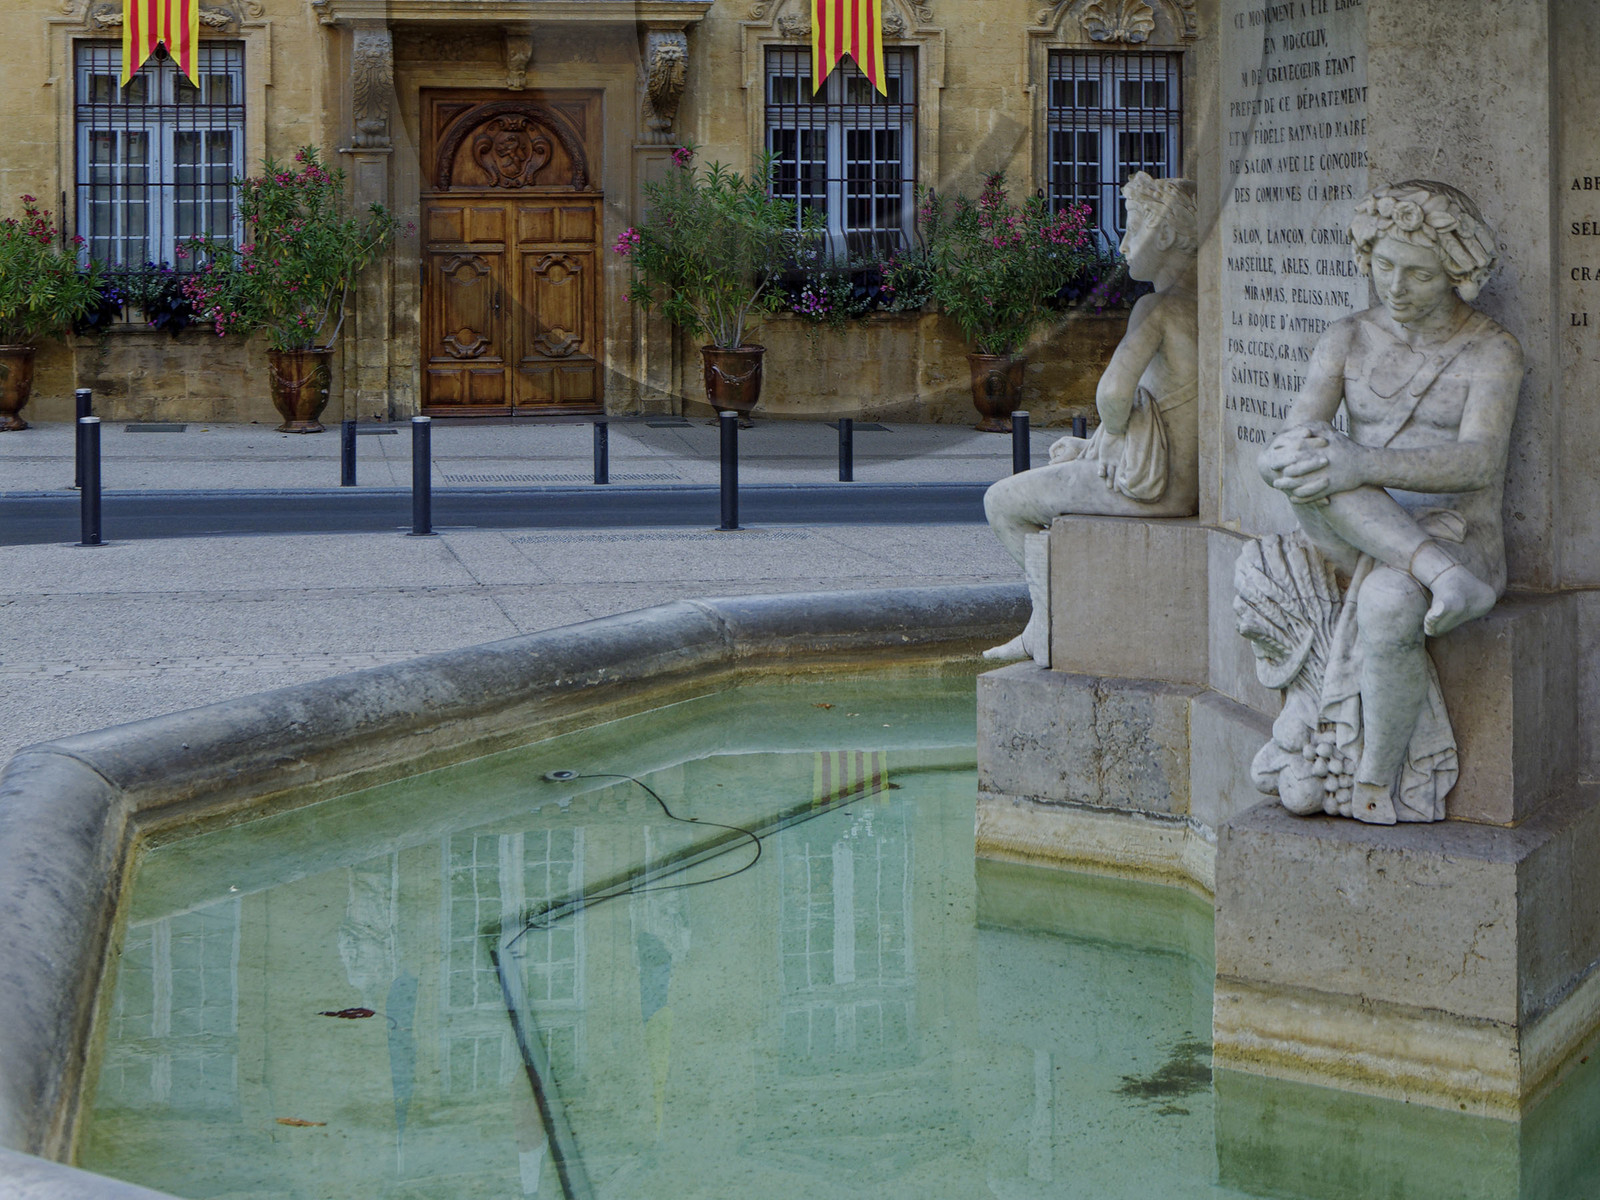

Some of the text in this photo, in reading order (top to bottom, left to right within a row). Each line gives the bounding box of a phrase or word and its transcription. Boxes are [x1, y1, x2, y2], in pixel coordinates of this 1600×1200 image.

[1234, 13, 1244, 29] CE
[1248, 2, 1295, 27] MONUMENT
[1301, 2, 1306, 18] A
[1264, 37, 1275, 54] EN
[1251, 69, 1262, 86] DE
[1264, 97, 1275, 114] DE
[1279, 96, 1290, 112] CE
[1297, 87, 1368, 110] DÉPARTEMENT
[1288, 122, 1332, 142] RAYNAUD
[1335, 119, 1367, 138] MAIRE
[1230, 151, 1368, 174] DE SALON AVEC LE CONCOURS
[1234, 187, 1250, 203] DES
[1256, 186, 1302, 203] COMMUNES
[1232, 311, 1243, 326] LA
[1248, 313, 1276, 332] ROQUE
[1571, 313, 1588, 327] LI
[1232, 362, 1269, 388] SAINTES
[1226, 395, 1237, 411] LA
